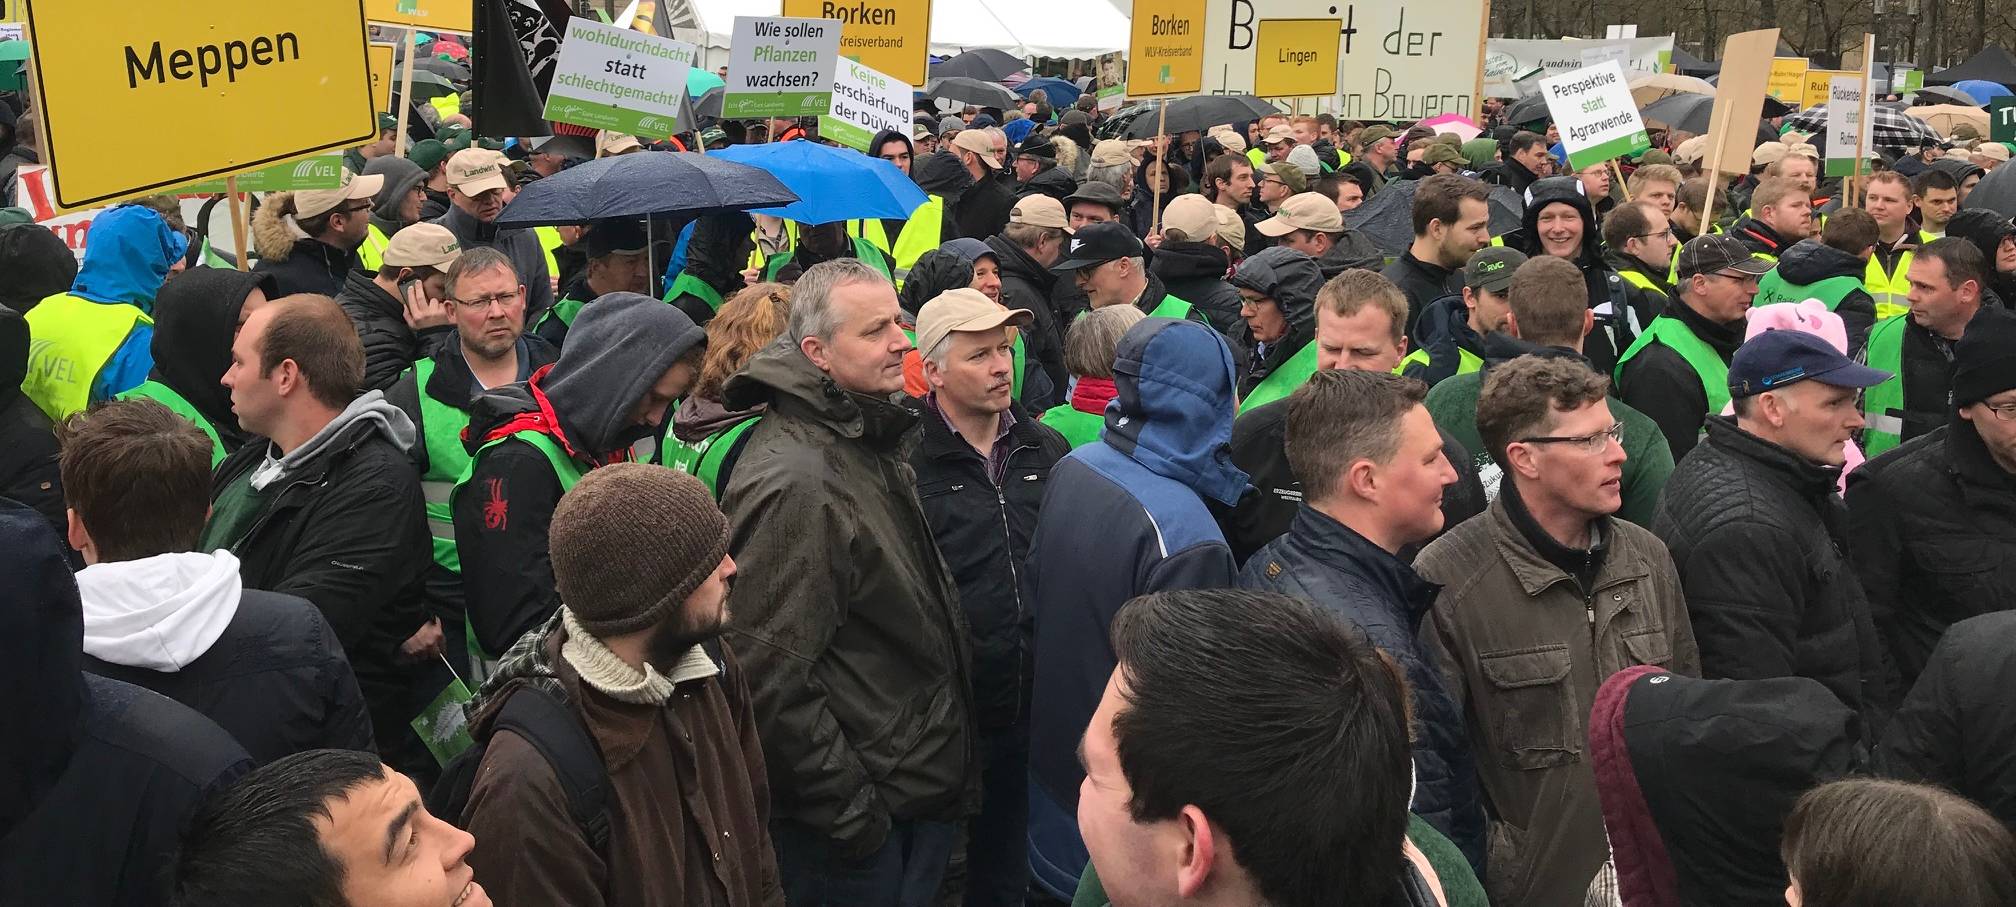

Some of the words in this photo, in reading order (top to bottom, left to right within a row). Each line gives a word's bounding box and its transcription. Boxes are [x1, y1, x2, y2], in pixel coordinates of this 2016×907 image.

[822, 1, 896, 25] Borken
[754, 21, 781, 37] Wie
[784, 23, 824, 38] sollen
[1152, 14, 1190, 36] Borken
[1383, 7, 1442, 56] der
[571, 26, 691, 63] wohldurchdacht
[753, 45, 817, 62] Pflanzen
[124, 31, 300, 89] Meppen
[1279, 47, 1317, 66] Lingen
[604, 59, 647, 80] statt
[746, 71, 819, 87] wachsen?
[849, 63, 887, 90] Keine
[557, 72, 679, 107] schlechtgemacht!
[1373, 68, 1470, 119] Bauern
[1552, 72, 1617, 99] Perspektive
[1810, 80, 1830, 91] Ruh
[814, 99, 828, 107] VEL
[833, 81, 909, 123] erschärfung
[835, 102, 857, 121] der
[1581, 95, 1607, 114] statt
[653, 121, 669, 132] VEL
[1569, 111, 1634, 142] Agrarwende
[314, 165, 336, 177] VEL
[43, 354, 77, 384] VEL
